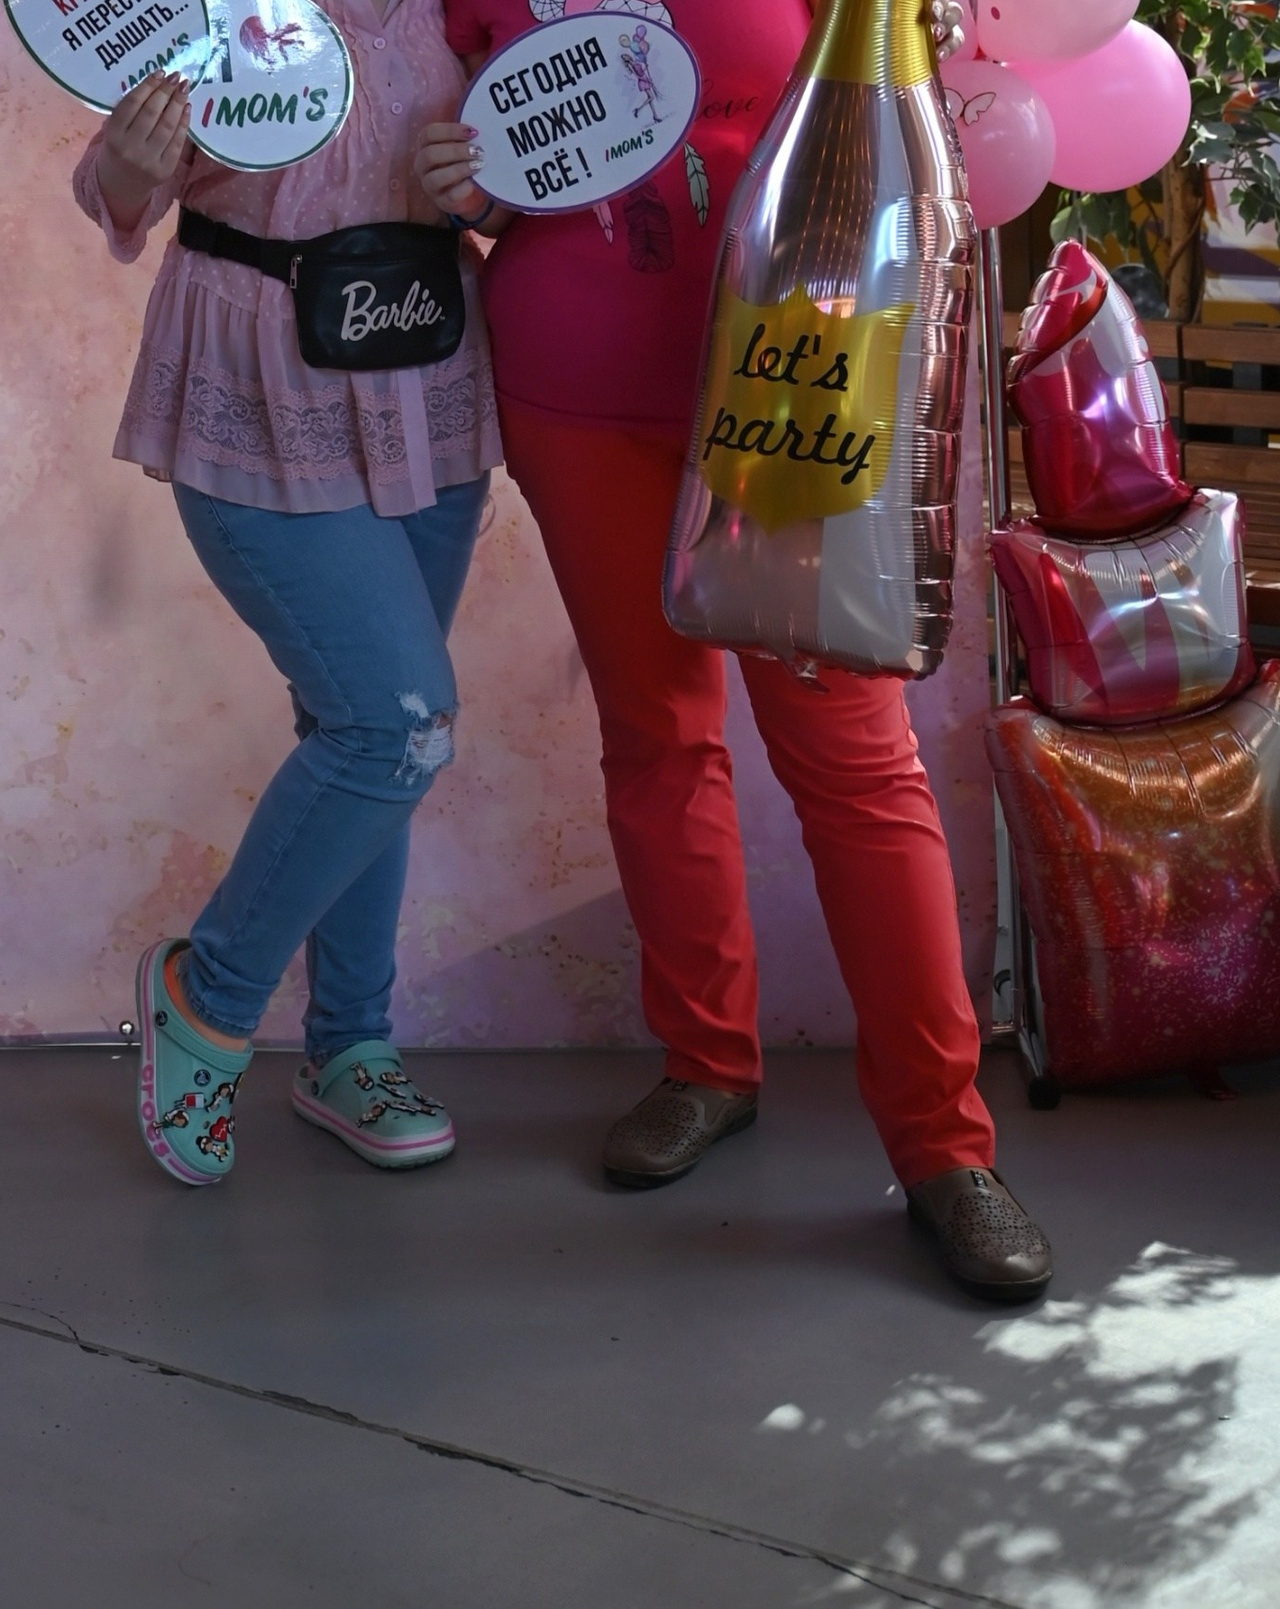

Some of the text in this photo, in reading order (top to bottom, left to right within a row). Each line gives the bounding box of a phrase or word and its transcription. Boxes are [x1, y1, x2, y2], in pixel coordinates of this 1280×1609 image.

[62, 29, 83, 52] Я
[95, 3, 189, 71] ДЫШАТЬ...
[489, 37, 608, 114] СЕГОДНЯ
[506, 90, 607, 158] МОЖНО
[733, 323, 848, 391] let's
[702, 407, 876, 485] party
